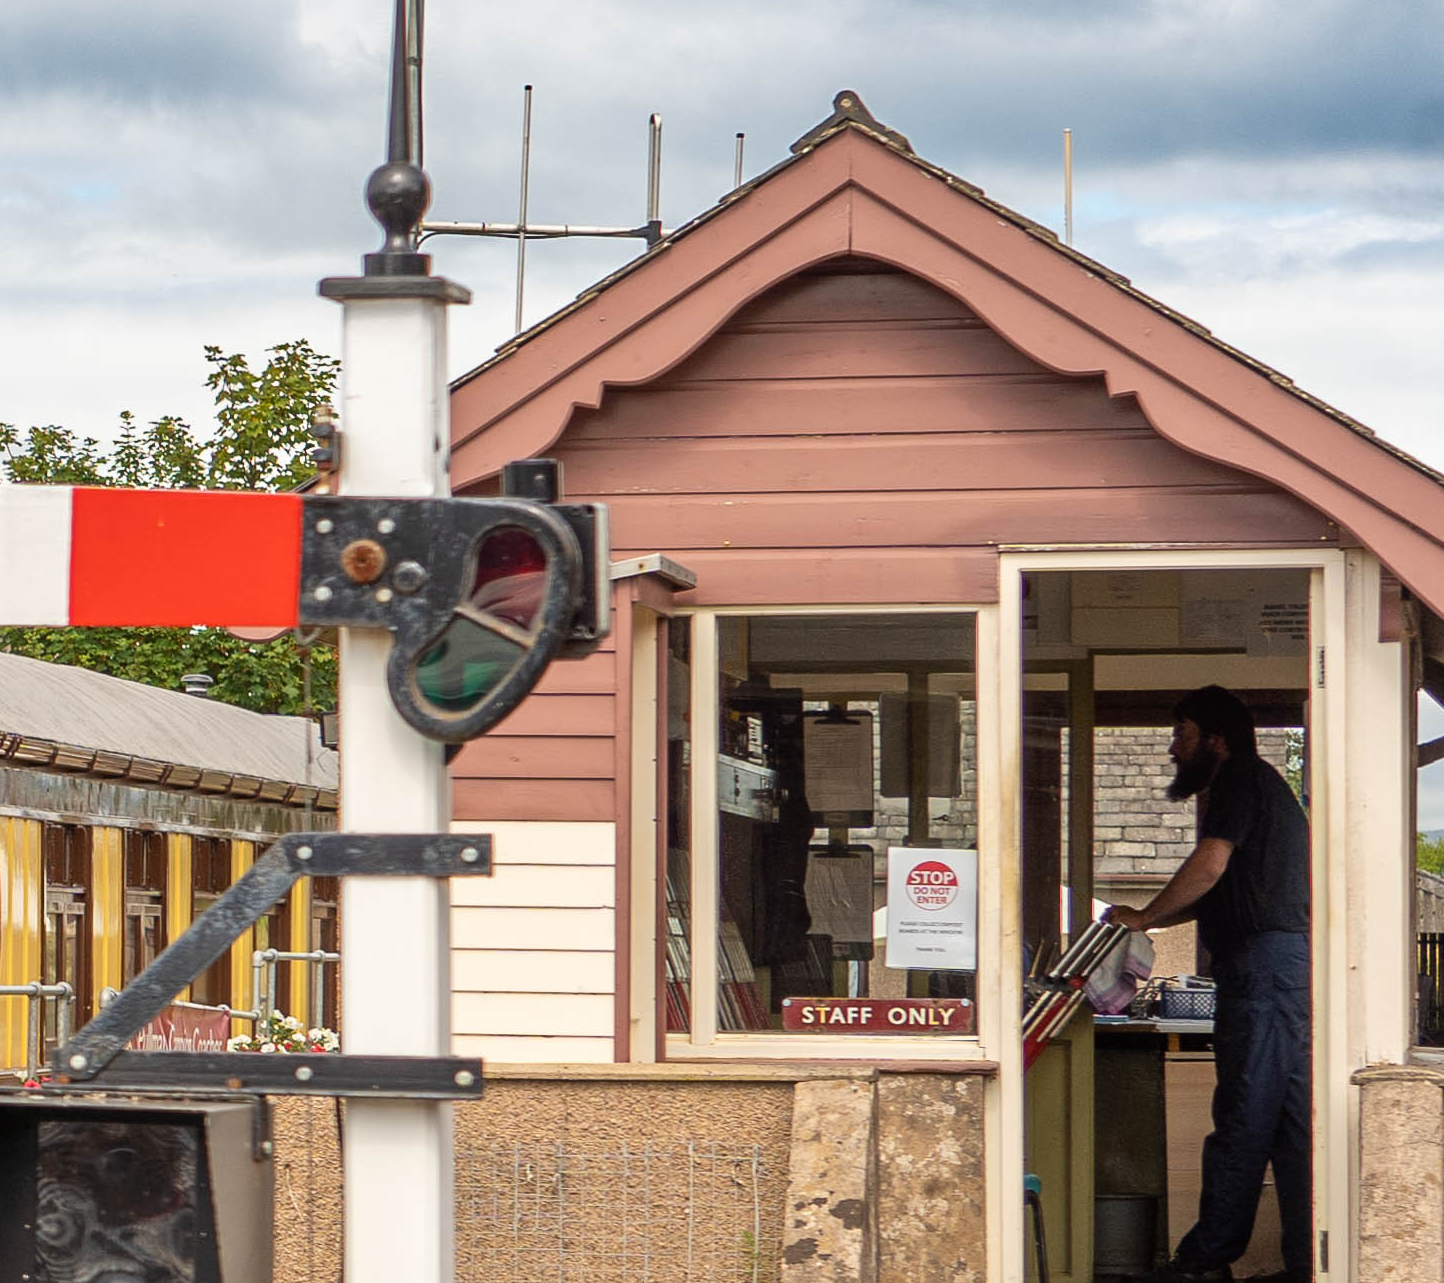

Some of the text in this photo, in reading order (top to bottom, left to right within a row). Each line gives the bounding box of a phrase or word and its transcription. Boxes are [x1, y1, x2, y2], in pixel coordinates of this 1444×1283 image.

[911, 871, 955, 885] STOP
[914, 887, 951, 895] DO NOT
[917, 896, 948, 904] ENTER
[802, 1007, 955, 1026] STAFF ONLY
